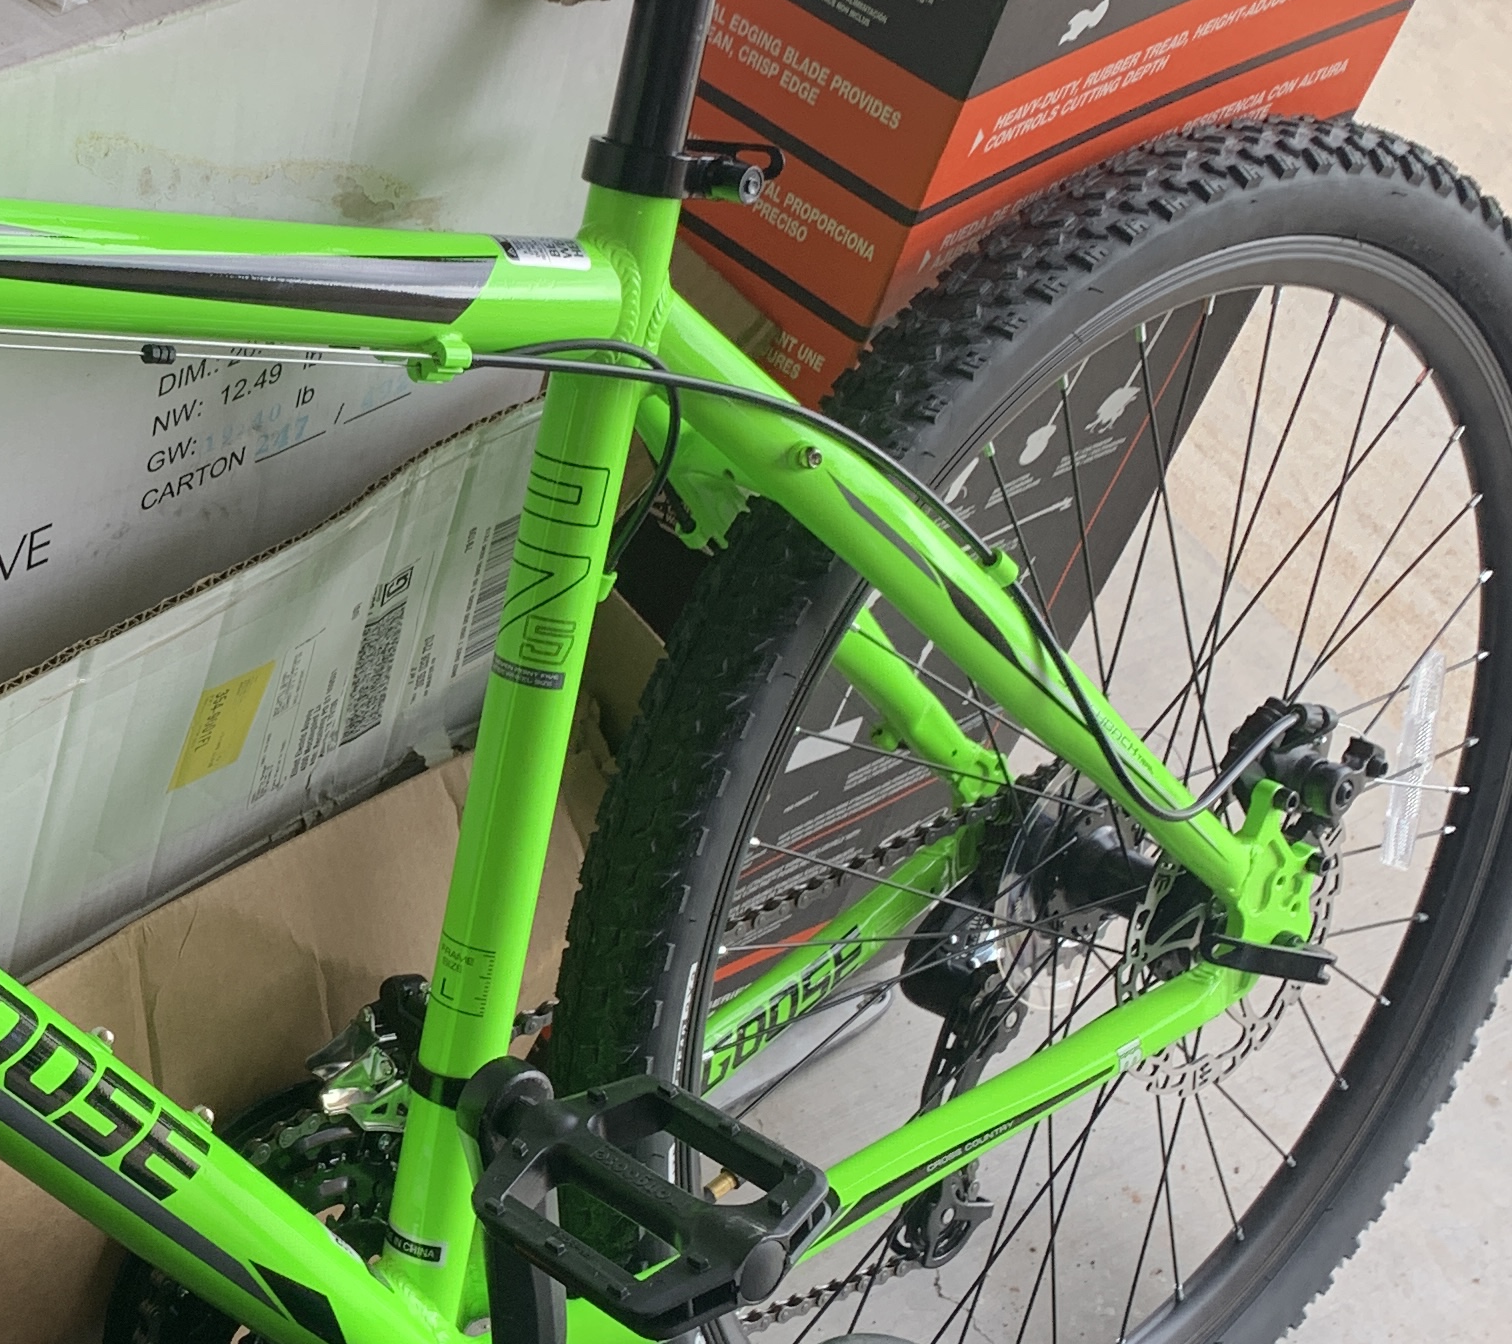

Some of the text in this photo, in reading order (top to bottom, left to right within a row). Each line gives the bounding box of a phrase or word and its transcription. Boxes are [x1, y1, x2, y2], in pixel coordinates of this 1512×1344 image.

[729, 13, 783, 56] EDGING
[783, 46, 830, 86] BLADE
[829, 74, 902, 130] PROVIDES
[738, 44, 781, 79] CRISP
[779, 70, 821, 106] EDGE
[992, 77, 1082, 132] HEAVY-DUTY,
[1083, 51, 1142, 89] RUBBER
[1142, 29, 1190, 63] TREAD,
[1267, 79, 1299, 103] CON
[1297, 58, 1350, 89] ALTURA
[984, 54, 1171, 153] CONTROLS CUTTING DEPTH
[751, 197, 809, 243] PRECISO
[783, 191, 876, 262] PROPORCIONA
[147, 437, 197, 473] GW:
[295, 386, 315, 408] lb
[152, 398, 204, 436] NW:
[221, 363, 283, 405] 12.49
[141, 447, 246, 511] CARTON
[441, 943, 475, 966] FRAME
[442, 956, 463, 974] SIZE
[440, 977, 455, 1001] L
[703, 924, 862, 1092] GOOSE
[925, 1119, 1017, 1173] CROSS COUNTRY
[402, 1238, 437, 1260] CHINA
